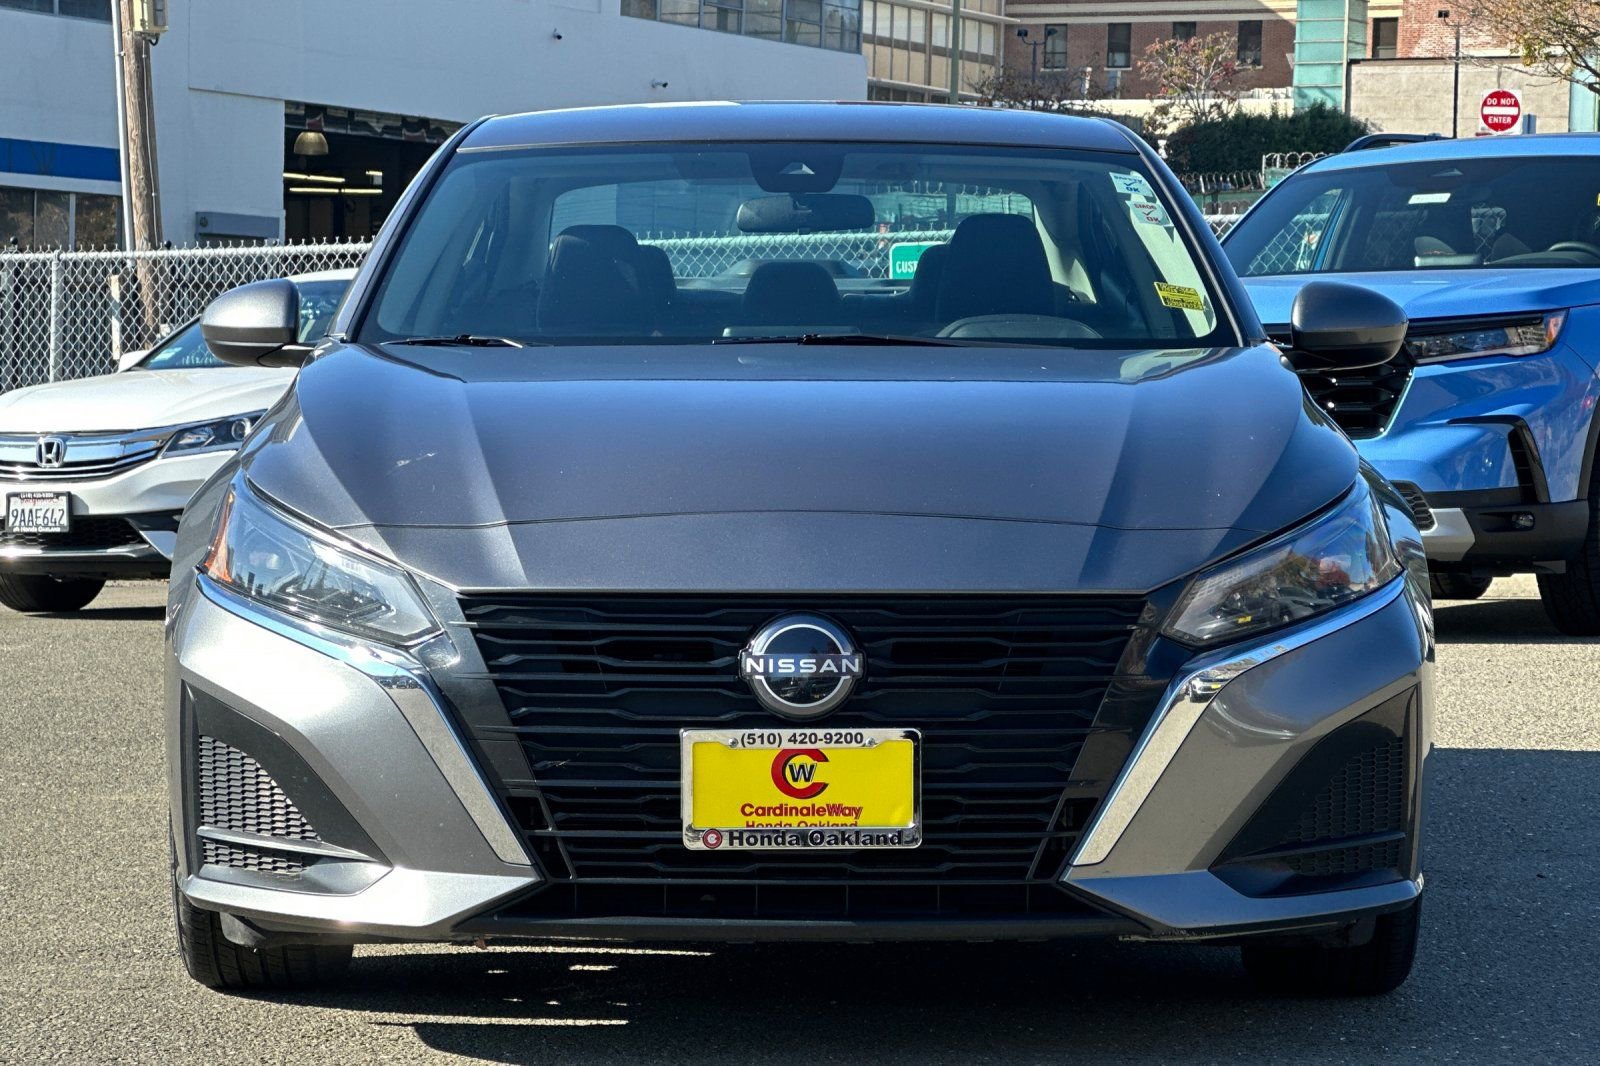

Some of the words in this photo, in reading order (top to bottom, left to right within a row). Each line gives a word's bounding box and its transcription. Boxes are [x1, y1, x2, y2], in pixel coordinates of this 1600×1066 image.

[1488, 116, 1512, 124] ENTER
[11, 508, 65, 527] 9AAE642
[746, 657, 860, 673] NISSAN
[740, 732, 782, 748] (510)
[788, 732, 864, 745] 420-9200
[740, 803, 863, 820] CardinaleWay
[728, 830, 800, 847] Honda
[808, 829, 901, 846] Oakland
